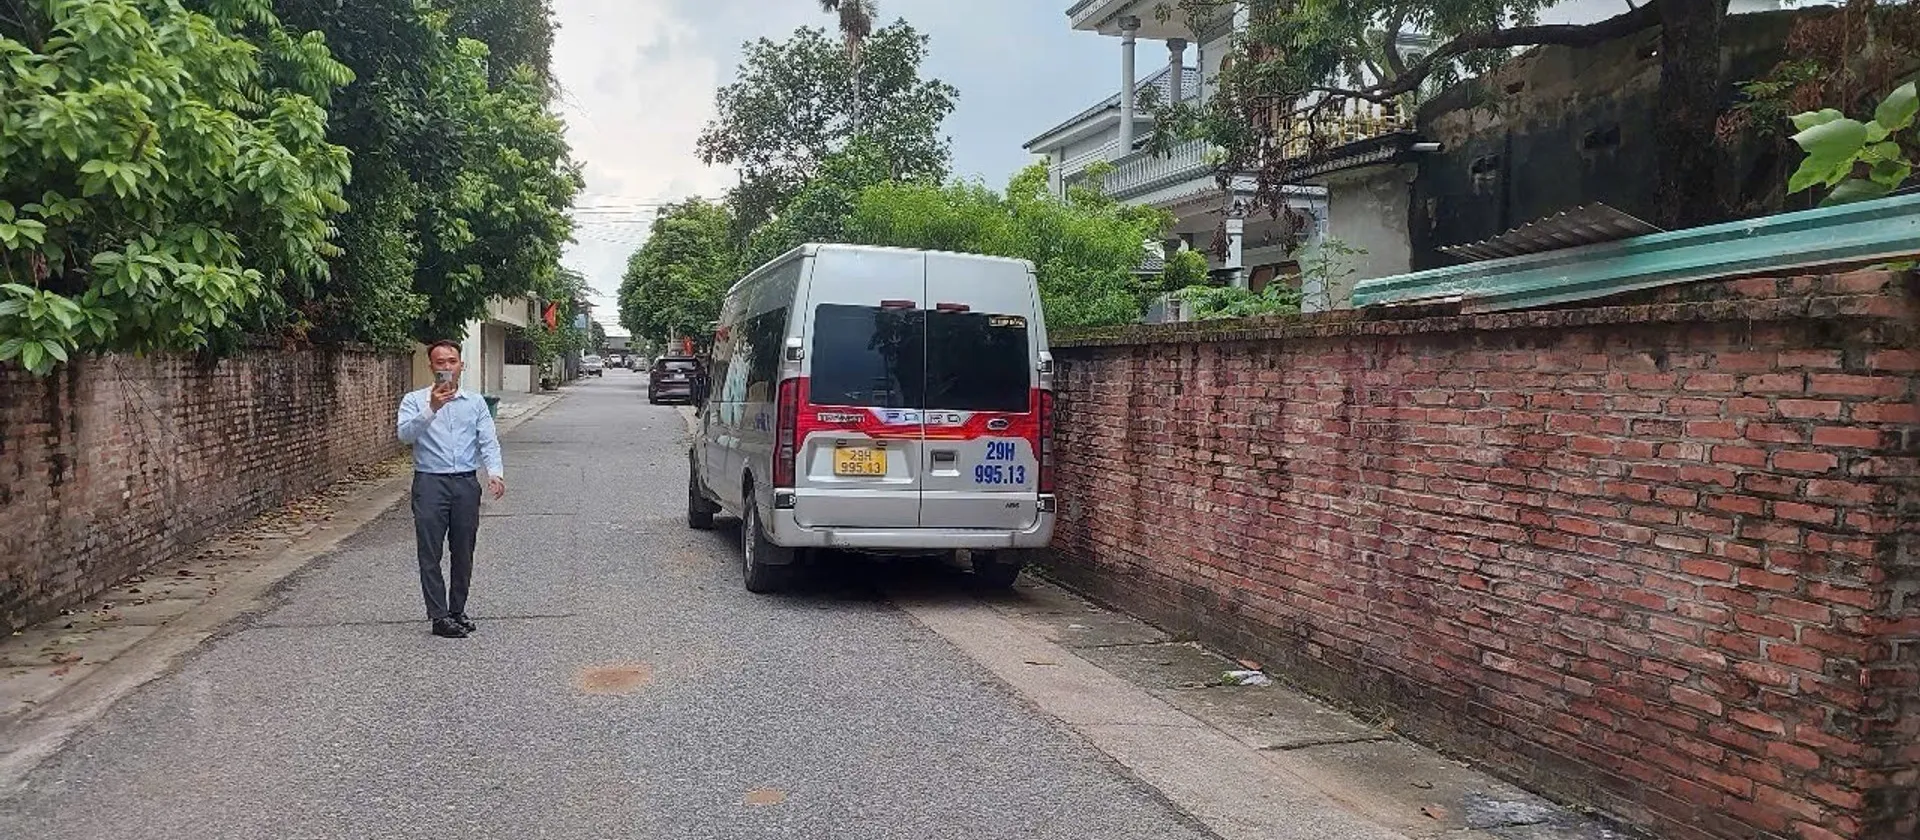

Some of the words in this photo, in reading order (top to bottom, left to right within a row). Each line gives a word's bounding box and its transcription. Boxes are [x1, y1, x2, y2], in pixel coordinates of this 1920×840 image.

[850, 449, 872, 462] 29H
[986, 441, 1015, 461] 29H
[841, 462, 881, 474] 995.13
[974, 464, 1025, 484] 995.13
